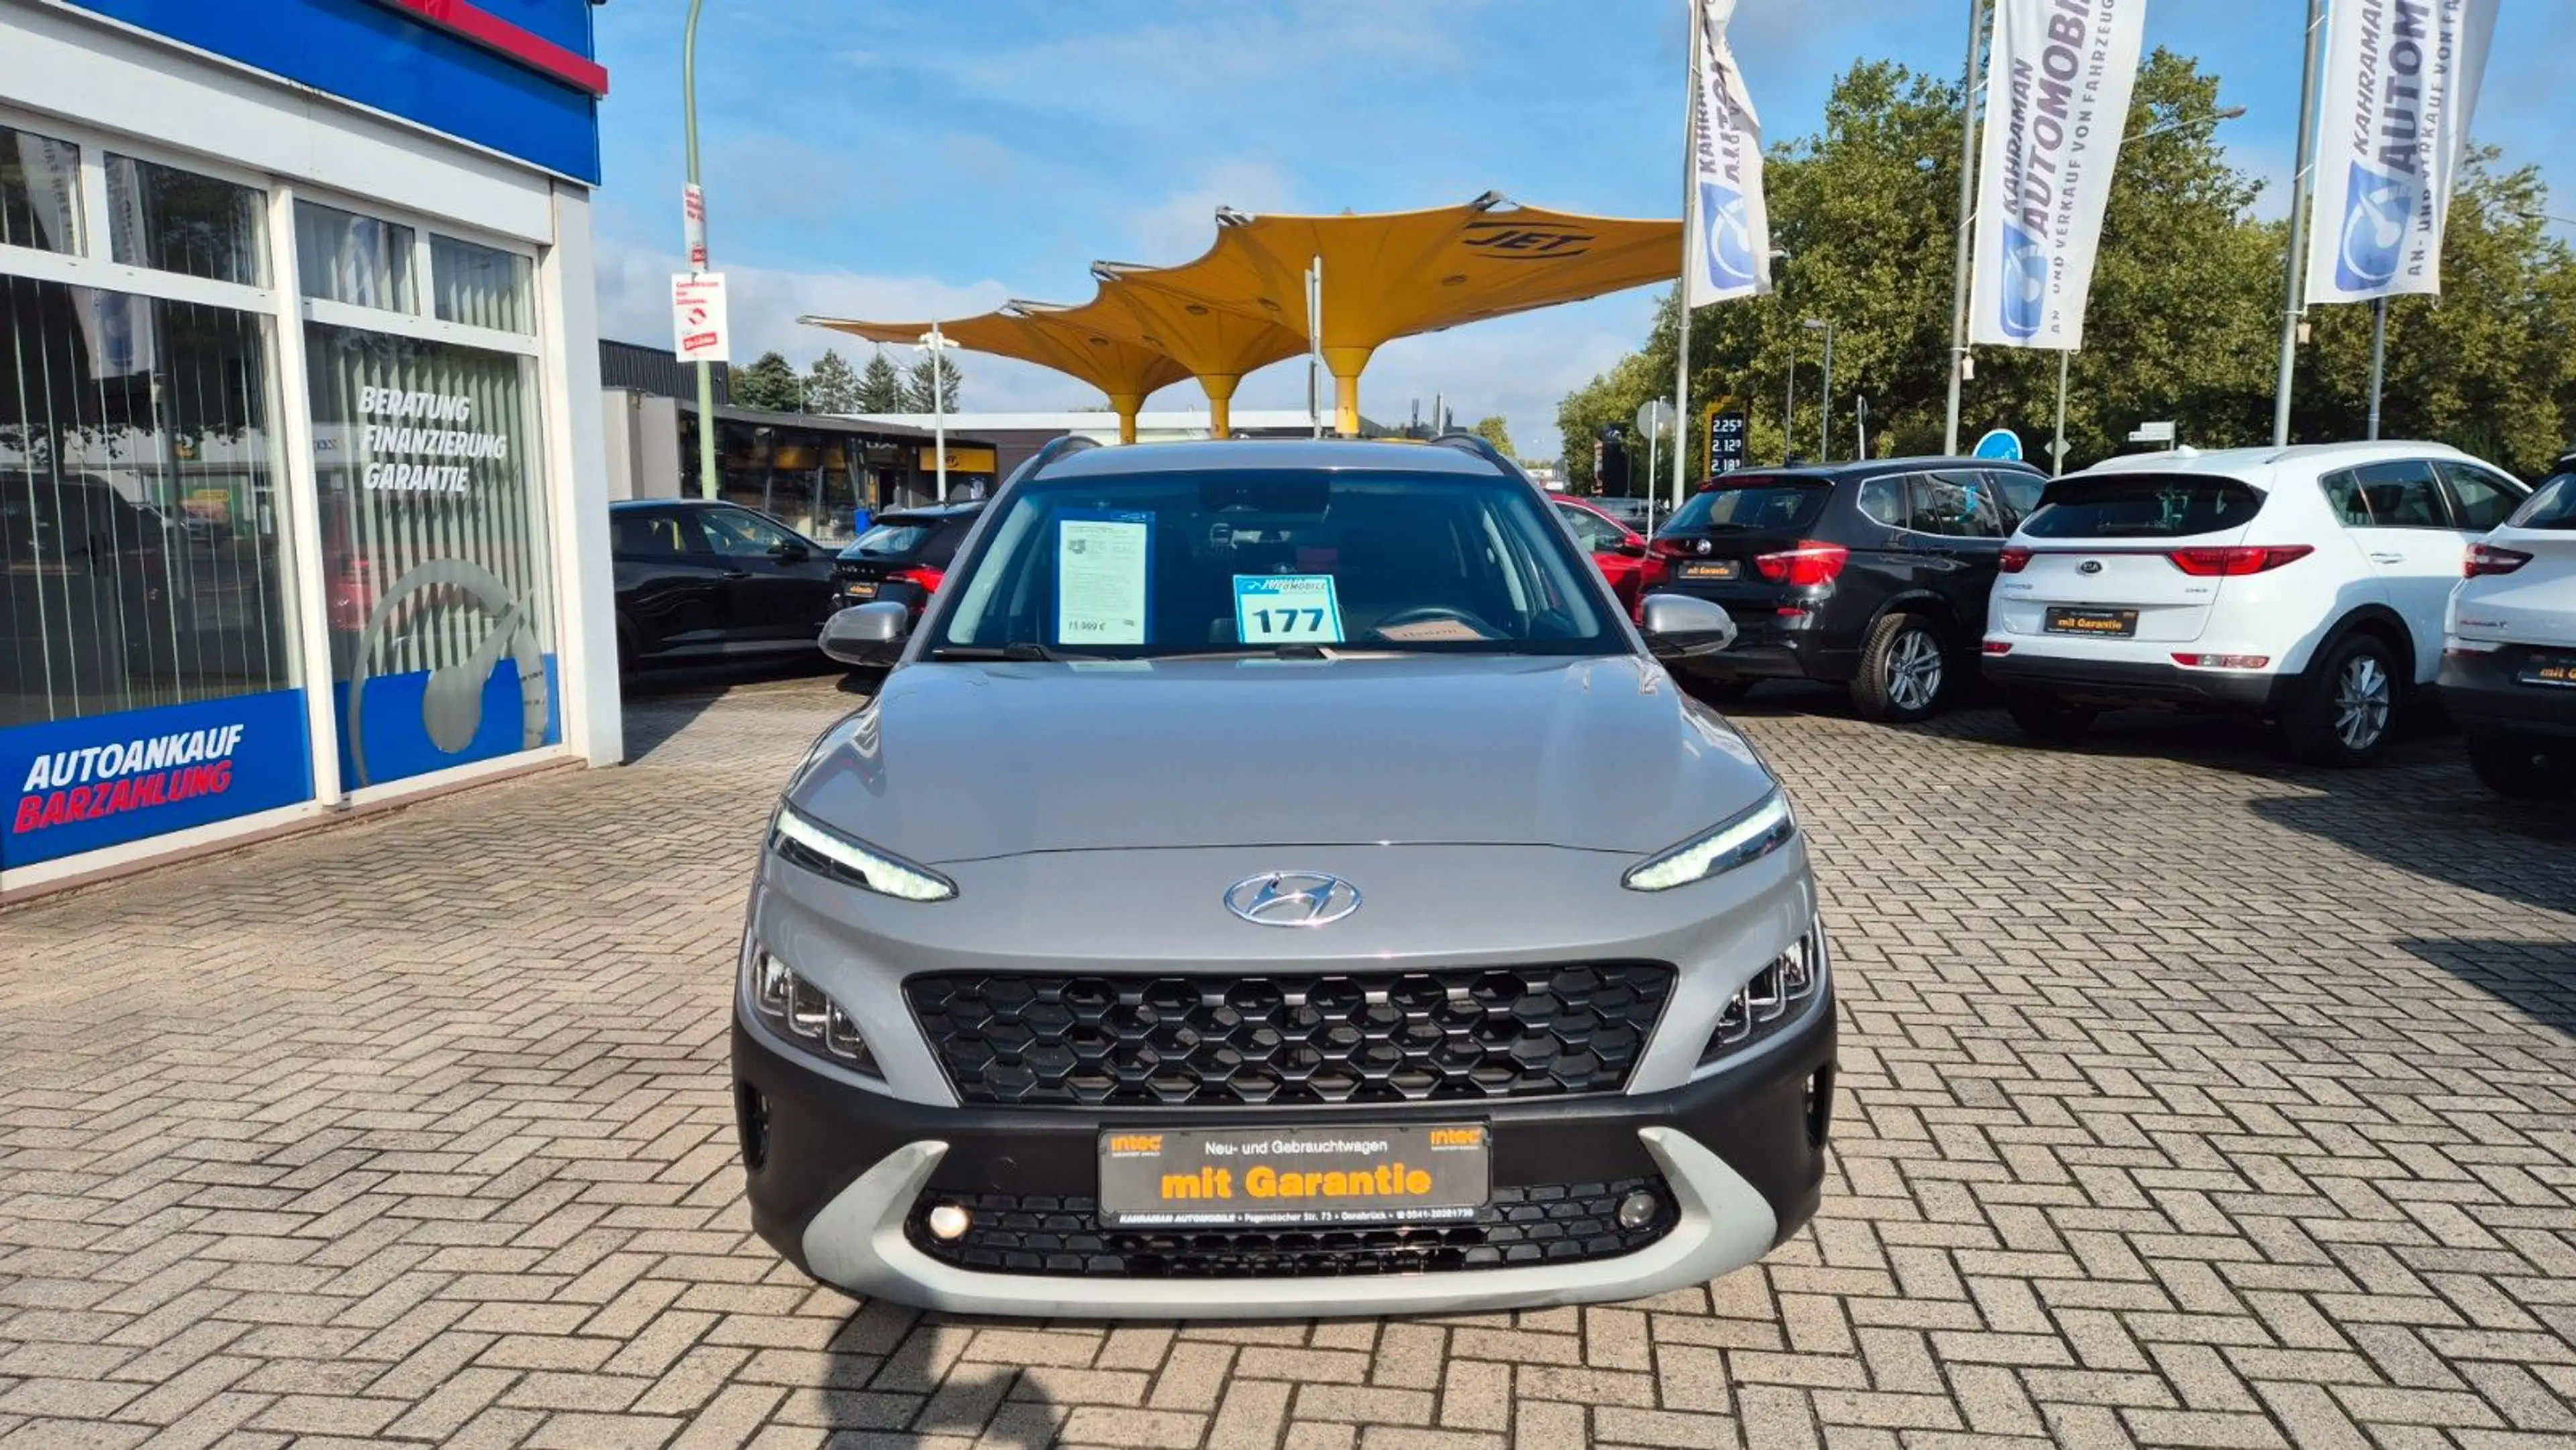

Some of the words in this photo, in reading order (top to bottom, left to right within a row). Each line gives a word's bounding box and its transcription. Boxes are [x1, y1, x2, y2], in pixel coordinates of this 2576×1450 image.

[2433, 31, 2453, 74] VON
[2003, 58, 2033, 215] KAHRAMAN
[2023, 0, 2091, 240] AUTOMOBI
[2055, 160, 2082, 249] VERKAUF
[2072, 110, 2093, 152] VON
[1462, 230, 1597, 251] JET
[358, 386, 470, 422] BERATUNG
[363, 425, 506, 459] FINANZIERUNG
[364, 462, 470, 492] GARANTIE
[1252, 608, 1325, 634] 177
[2077, 618, 2123, 630] Garantie
[23, 724, 244, 791] AUTOANKAUF
[13, 759, 232, 834] BARZAHLUNG
[1205, 1141, 1238, 1155] Neu-
[1243, 1139, 1268, 1155] und
[1272, 1139, 1389, 1155] Gebrauchtwagen
[1161, 1166, 1232, 1199] mit
[1245, 1162, 1432, 1198] Garantie
